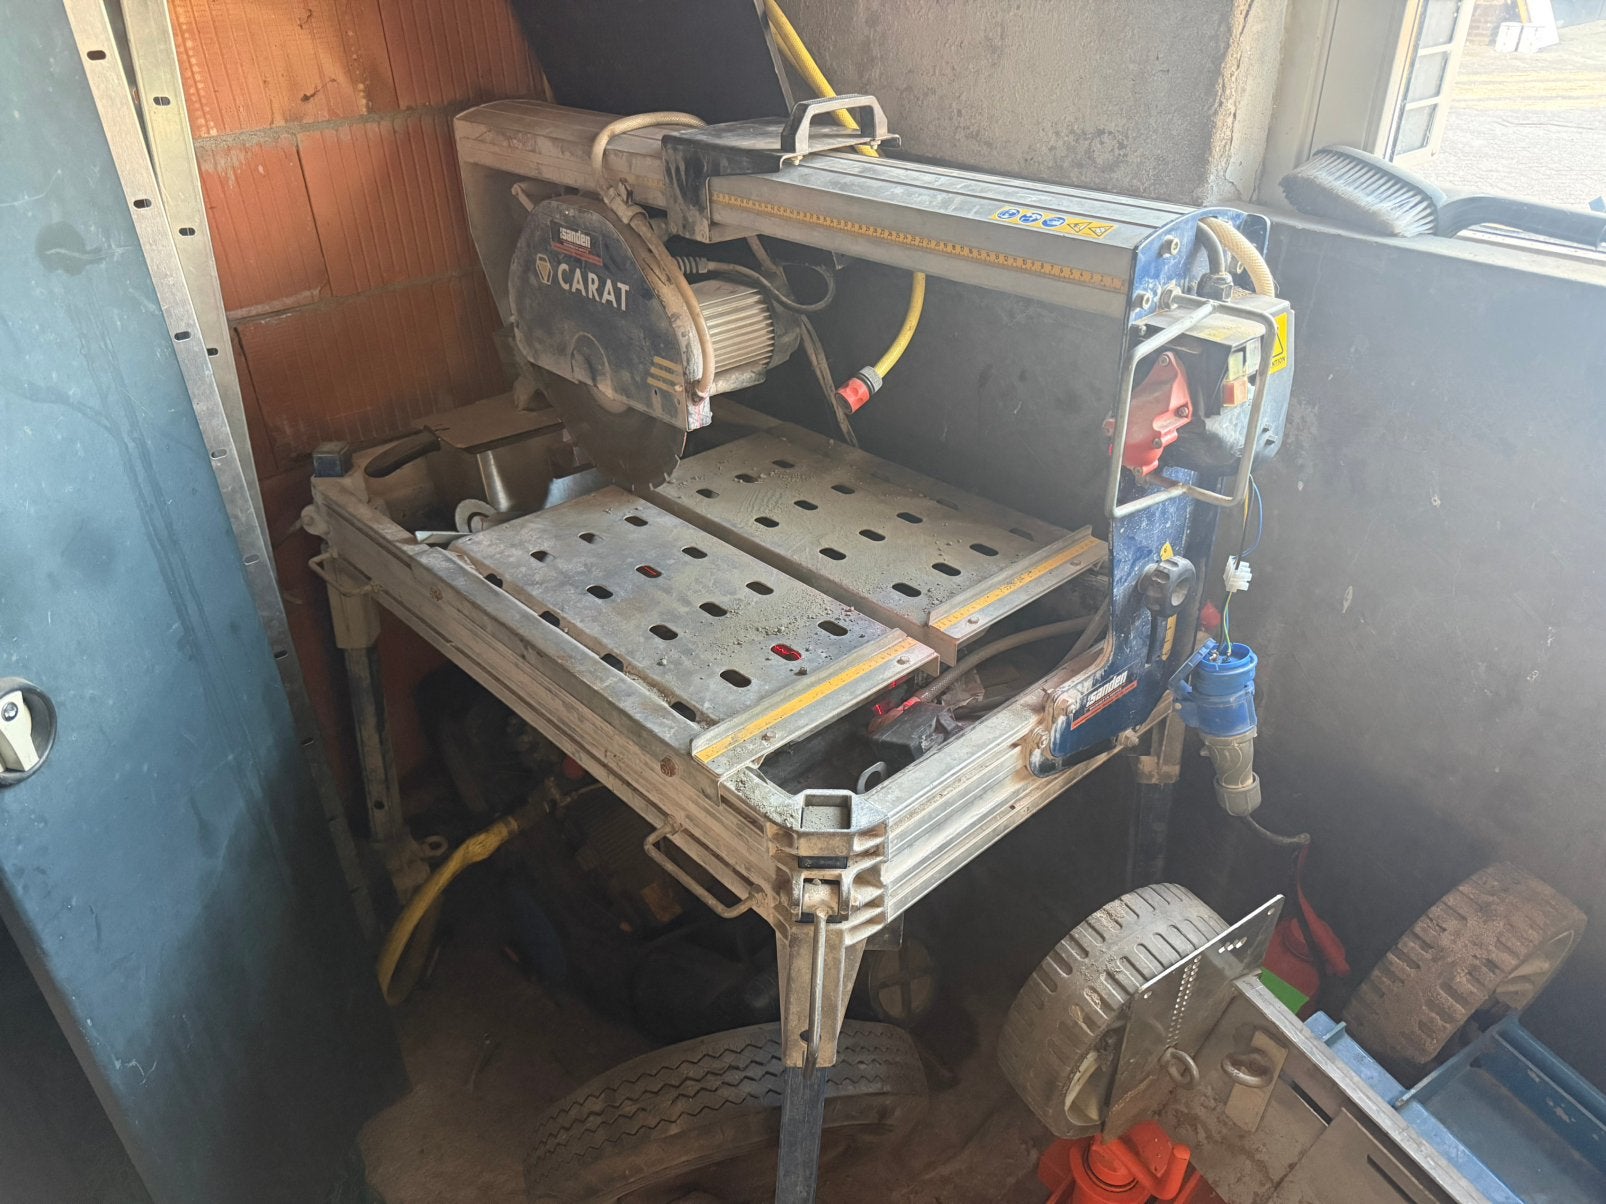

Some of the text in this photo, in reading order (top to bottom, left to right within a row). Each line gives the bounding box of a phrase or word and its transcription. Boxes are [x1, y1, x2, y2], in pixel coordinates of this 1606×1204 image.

[562, 228, 591, 248] sanden
[557, 263, 630, 311] CARAT
[1090, 670, 1128, 703] sanden
